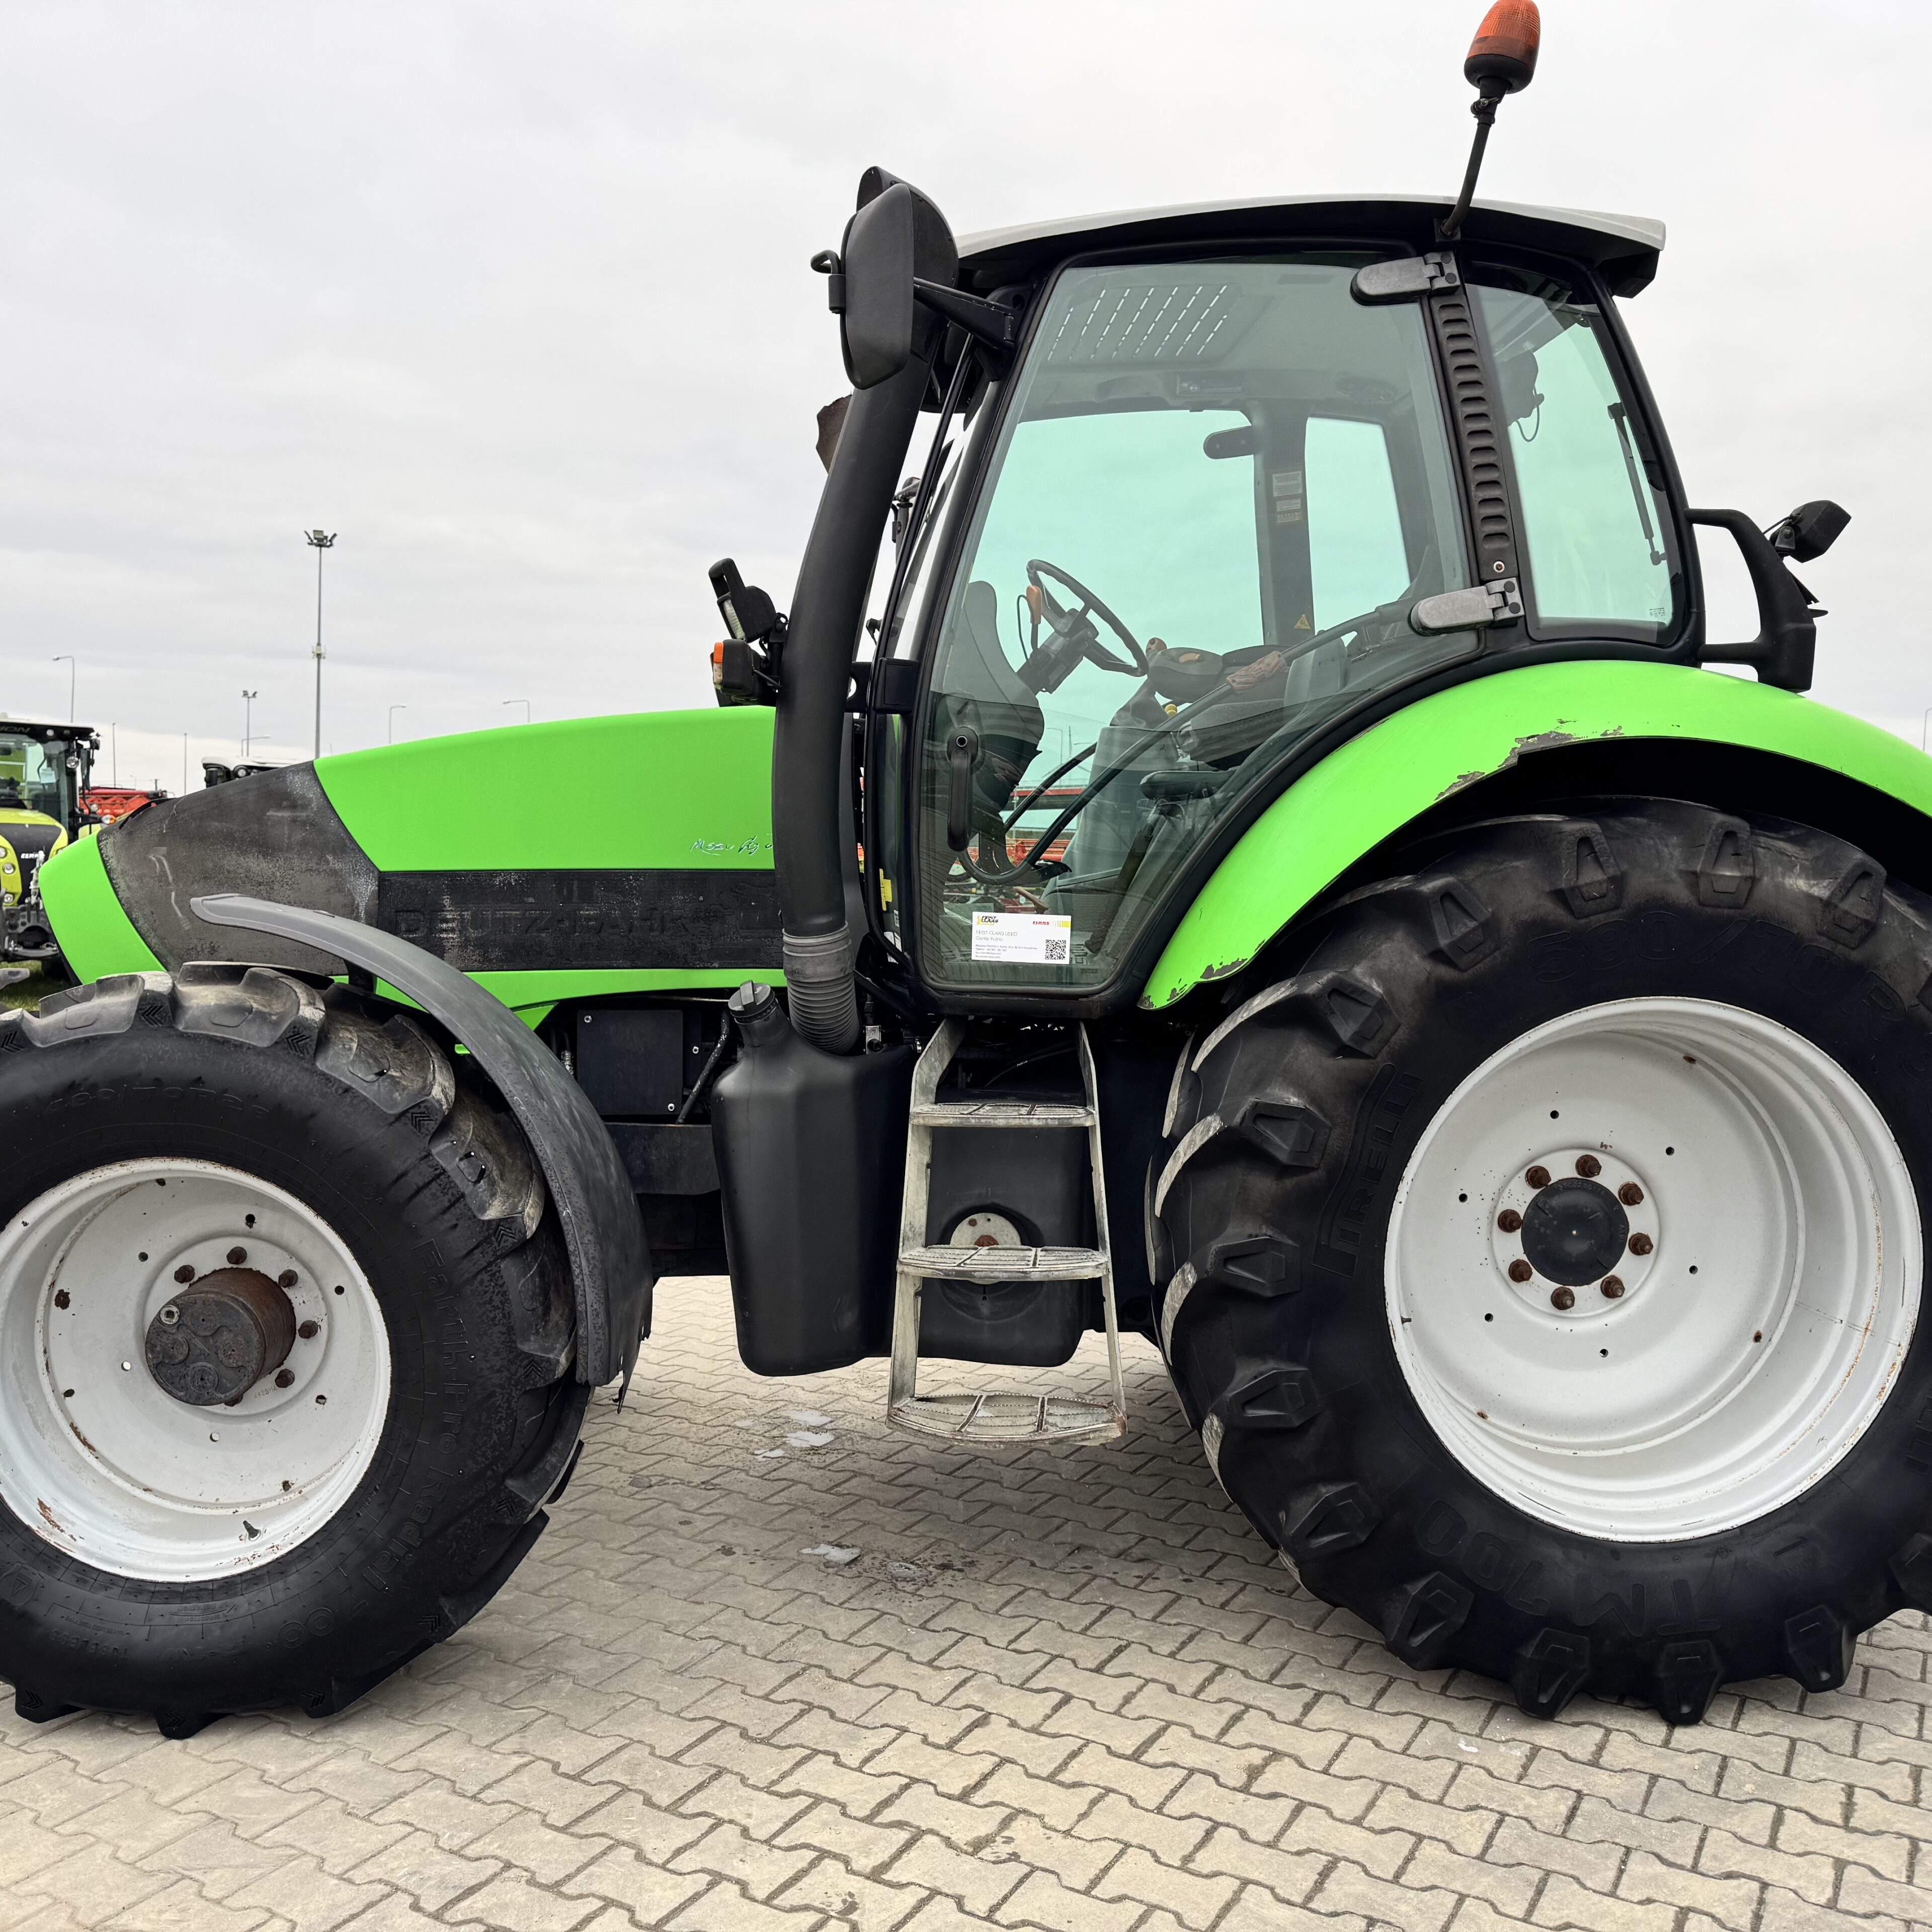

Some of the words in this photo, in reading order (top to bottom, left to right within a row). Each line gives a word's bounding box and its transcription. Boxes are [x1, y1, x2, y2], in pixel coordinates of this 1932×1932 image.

[1312, 1063, 1424, 1278] PIRELLI
[362, 1466, 454, 1590] Radial
[49, 1630, 128, 1659] TUBELESS
